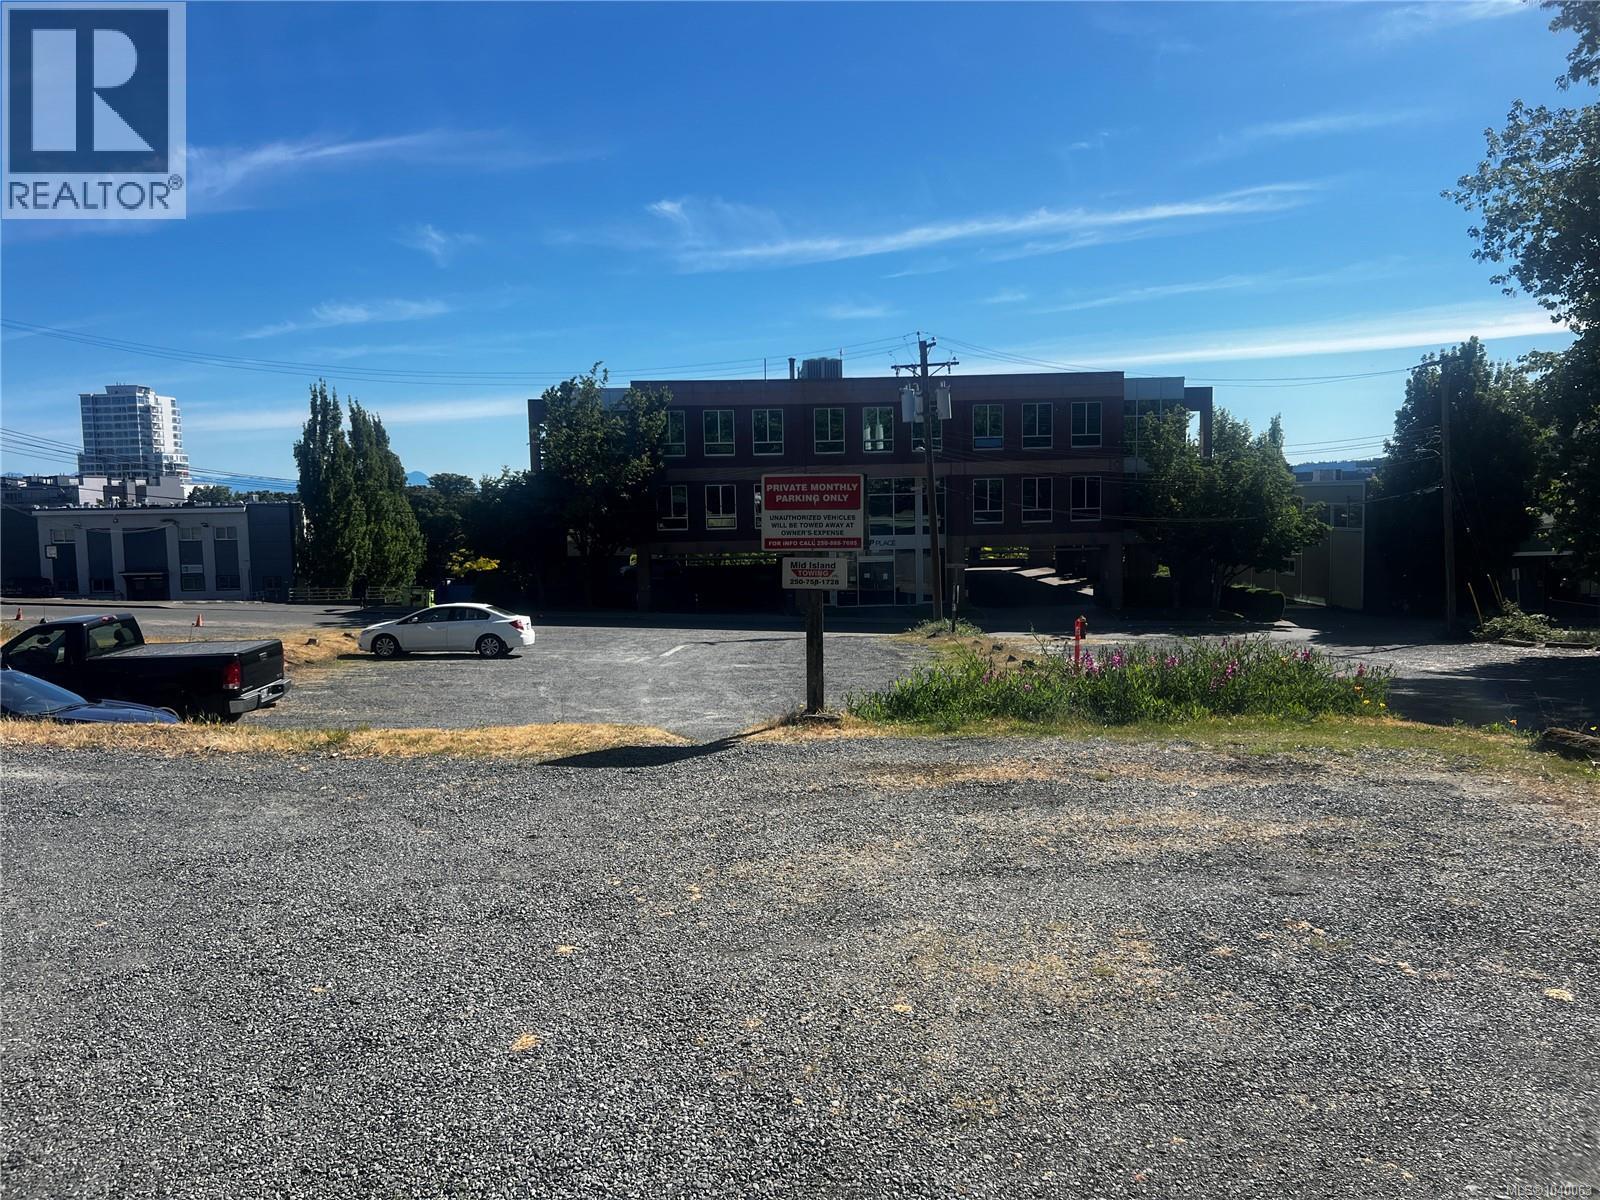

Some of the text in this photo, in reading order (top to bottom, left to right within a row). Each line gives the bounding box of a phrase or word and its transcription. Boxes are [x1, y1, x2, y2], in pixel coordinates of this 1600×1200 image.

[766, 483, 858, 492] PRIVATE MONTHLY
[776, 494, 849, 503] PARKING ONLY
[790, 561, 836, 569] Mid Island
